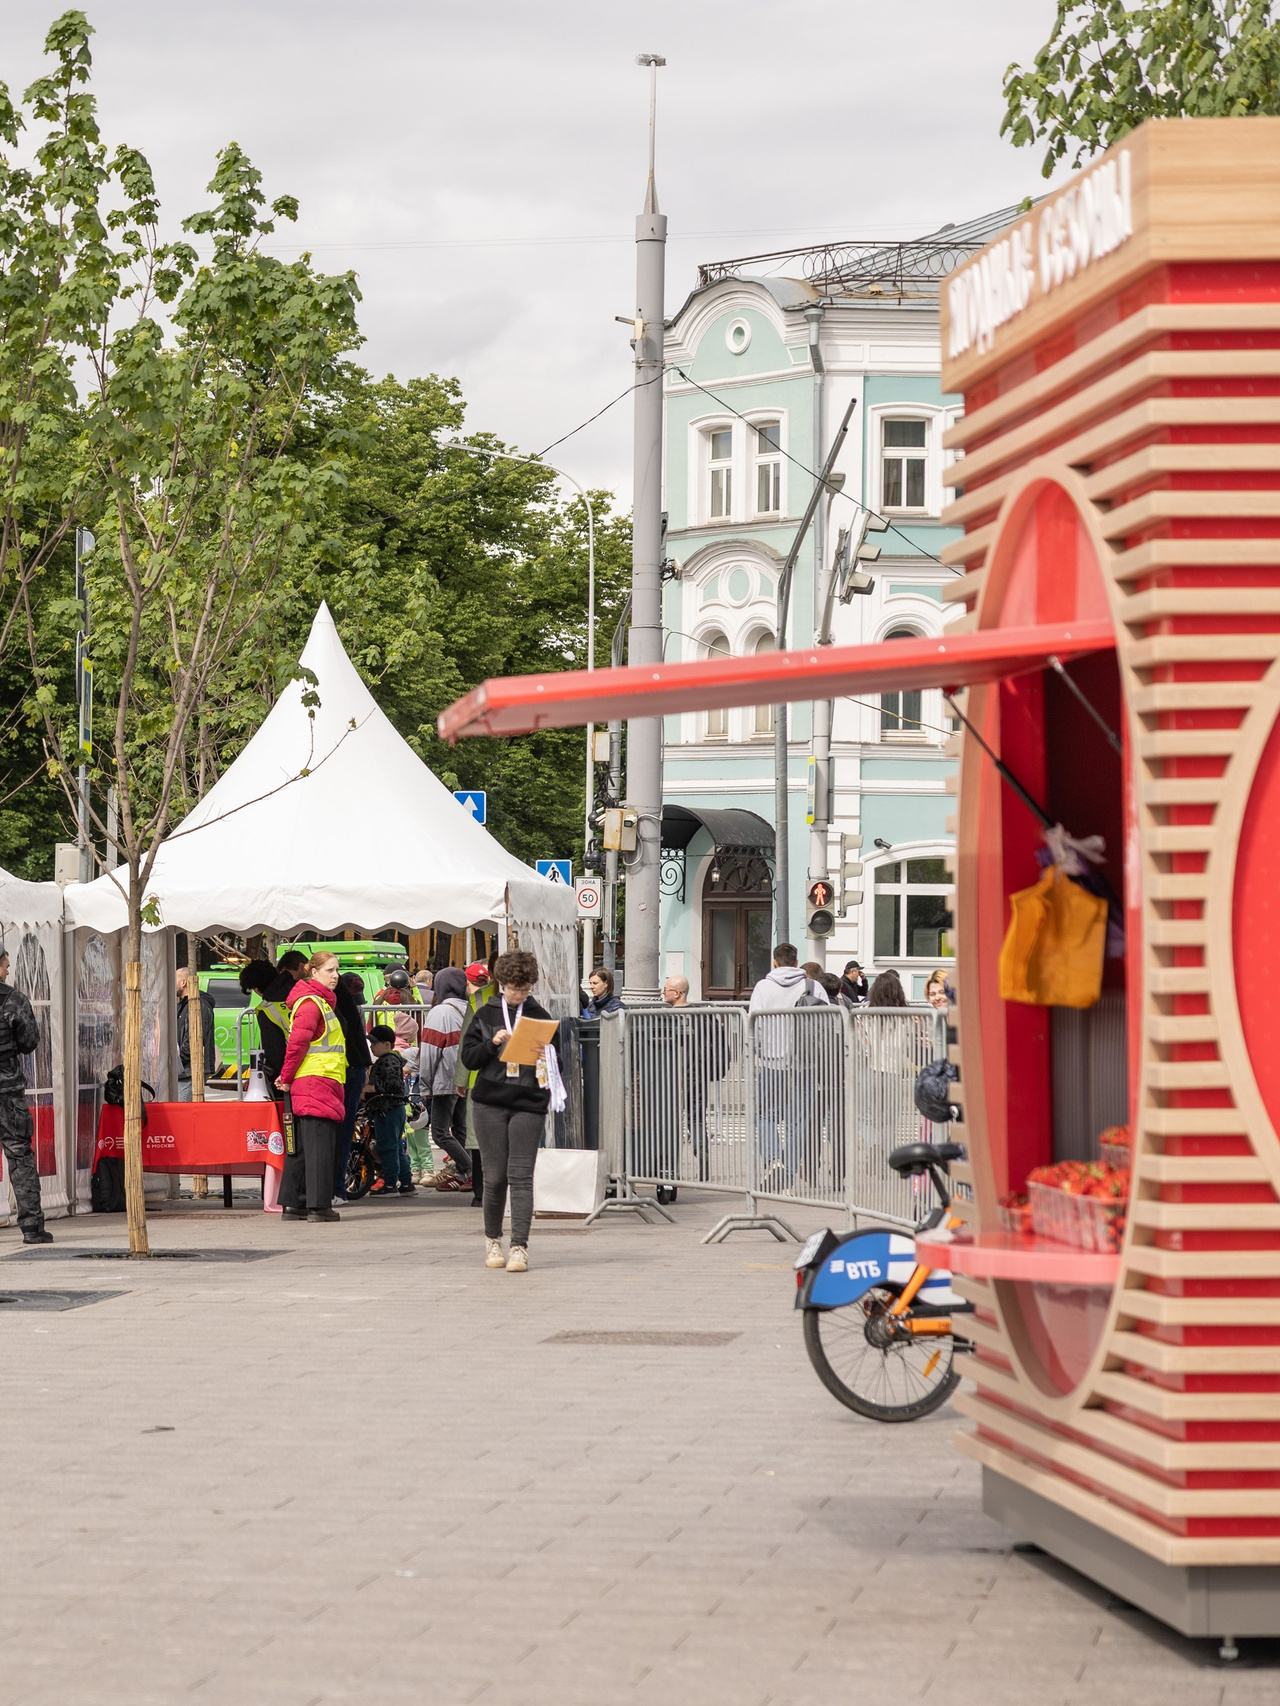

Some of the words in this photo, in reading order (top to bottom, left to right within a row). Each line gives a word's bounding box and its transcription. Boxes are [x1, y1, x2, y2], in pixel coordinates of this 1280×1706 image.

[582, 894, 594, 902] 50
[146, 1135, 175, 1144] ЛЕТО
[846, 1260, 881, 1280] ВТБ
